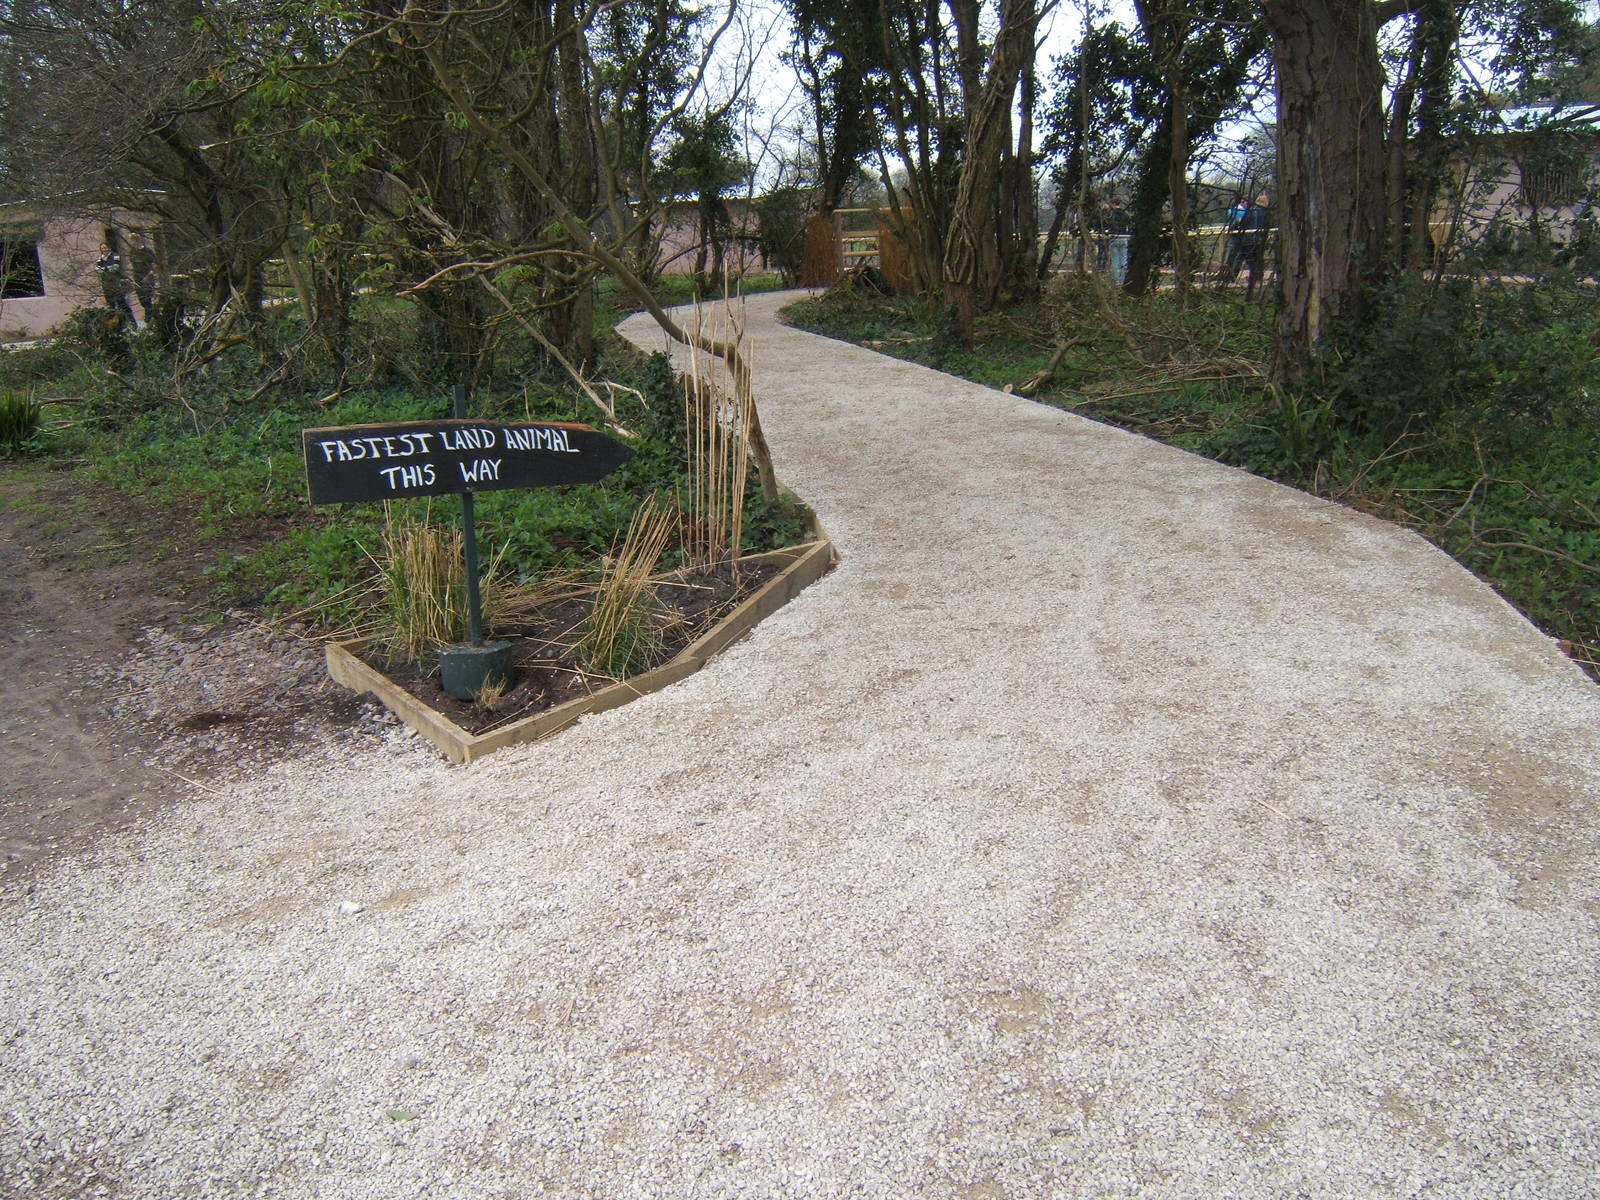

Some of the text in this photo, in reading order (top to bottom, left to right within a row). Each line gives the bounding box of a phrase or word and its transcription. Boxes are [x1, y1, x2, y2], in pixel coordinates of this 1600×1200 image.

[321, 428, 580, 462] FASTEST LAND ANIMAL
[380, 459, 502, 490] THIS WAY
